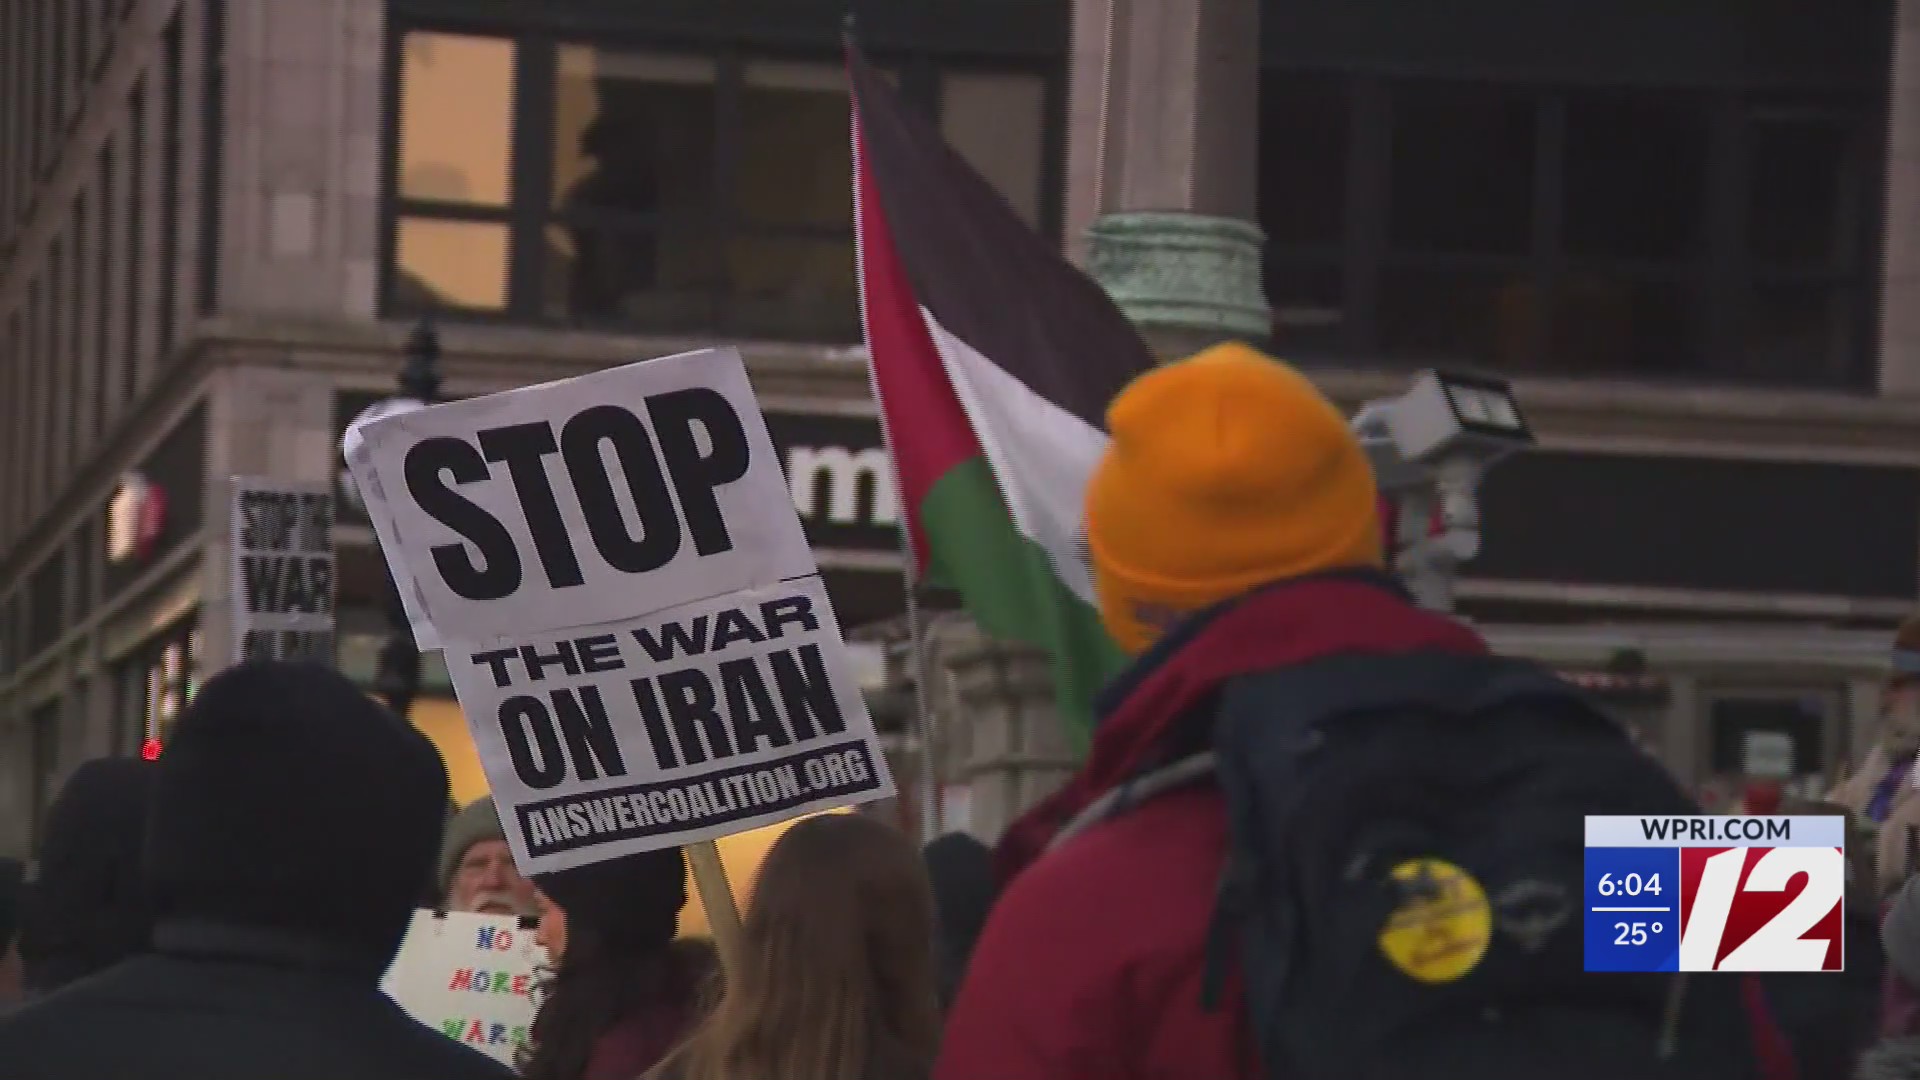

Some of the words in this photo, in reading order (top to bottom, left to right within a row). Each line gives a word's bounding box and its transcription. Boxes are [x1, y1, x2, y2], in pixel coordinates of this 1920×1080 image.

[404, 387, 750, 600] STOP
[242, 556, 331, 613] WAR
[471, 634, 626, 687] THE
[631, 595, 819, 662] WAR
[498, 685, 628, 788] ON
[630, 643, 847, 770] IRAN
[527, 750, 870, 847] ANSWERCOALITION.ORG
[475, 926, 513, 951] NO
[449, 968, 530, 996] MORE
[442, 1018, 528, 1045] WARS
